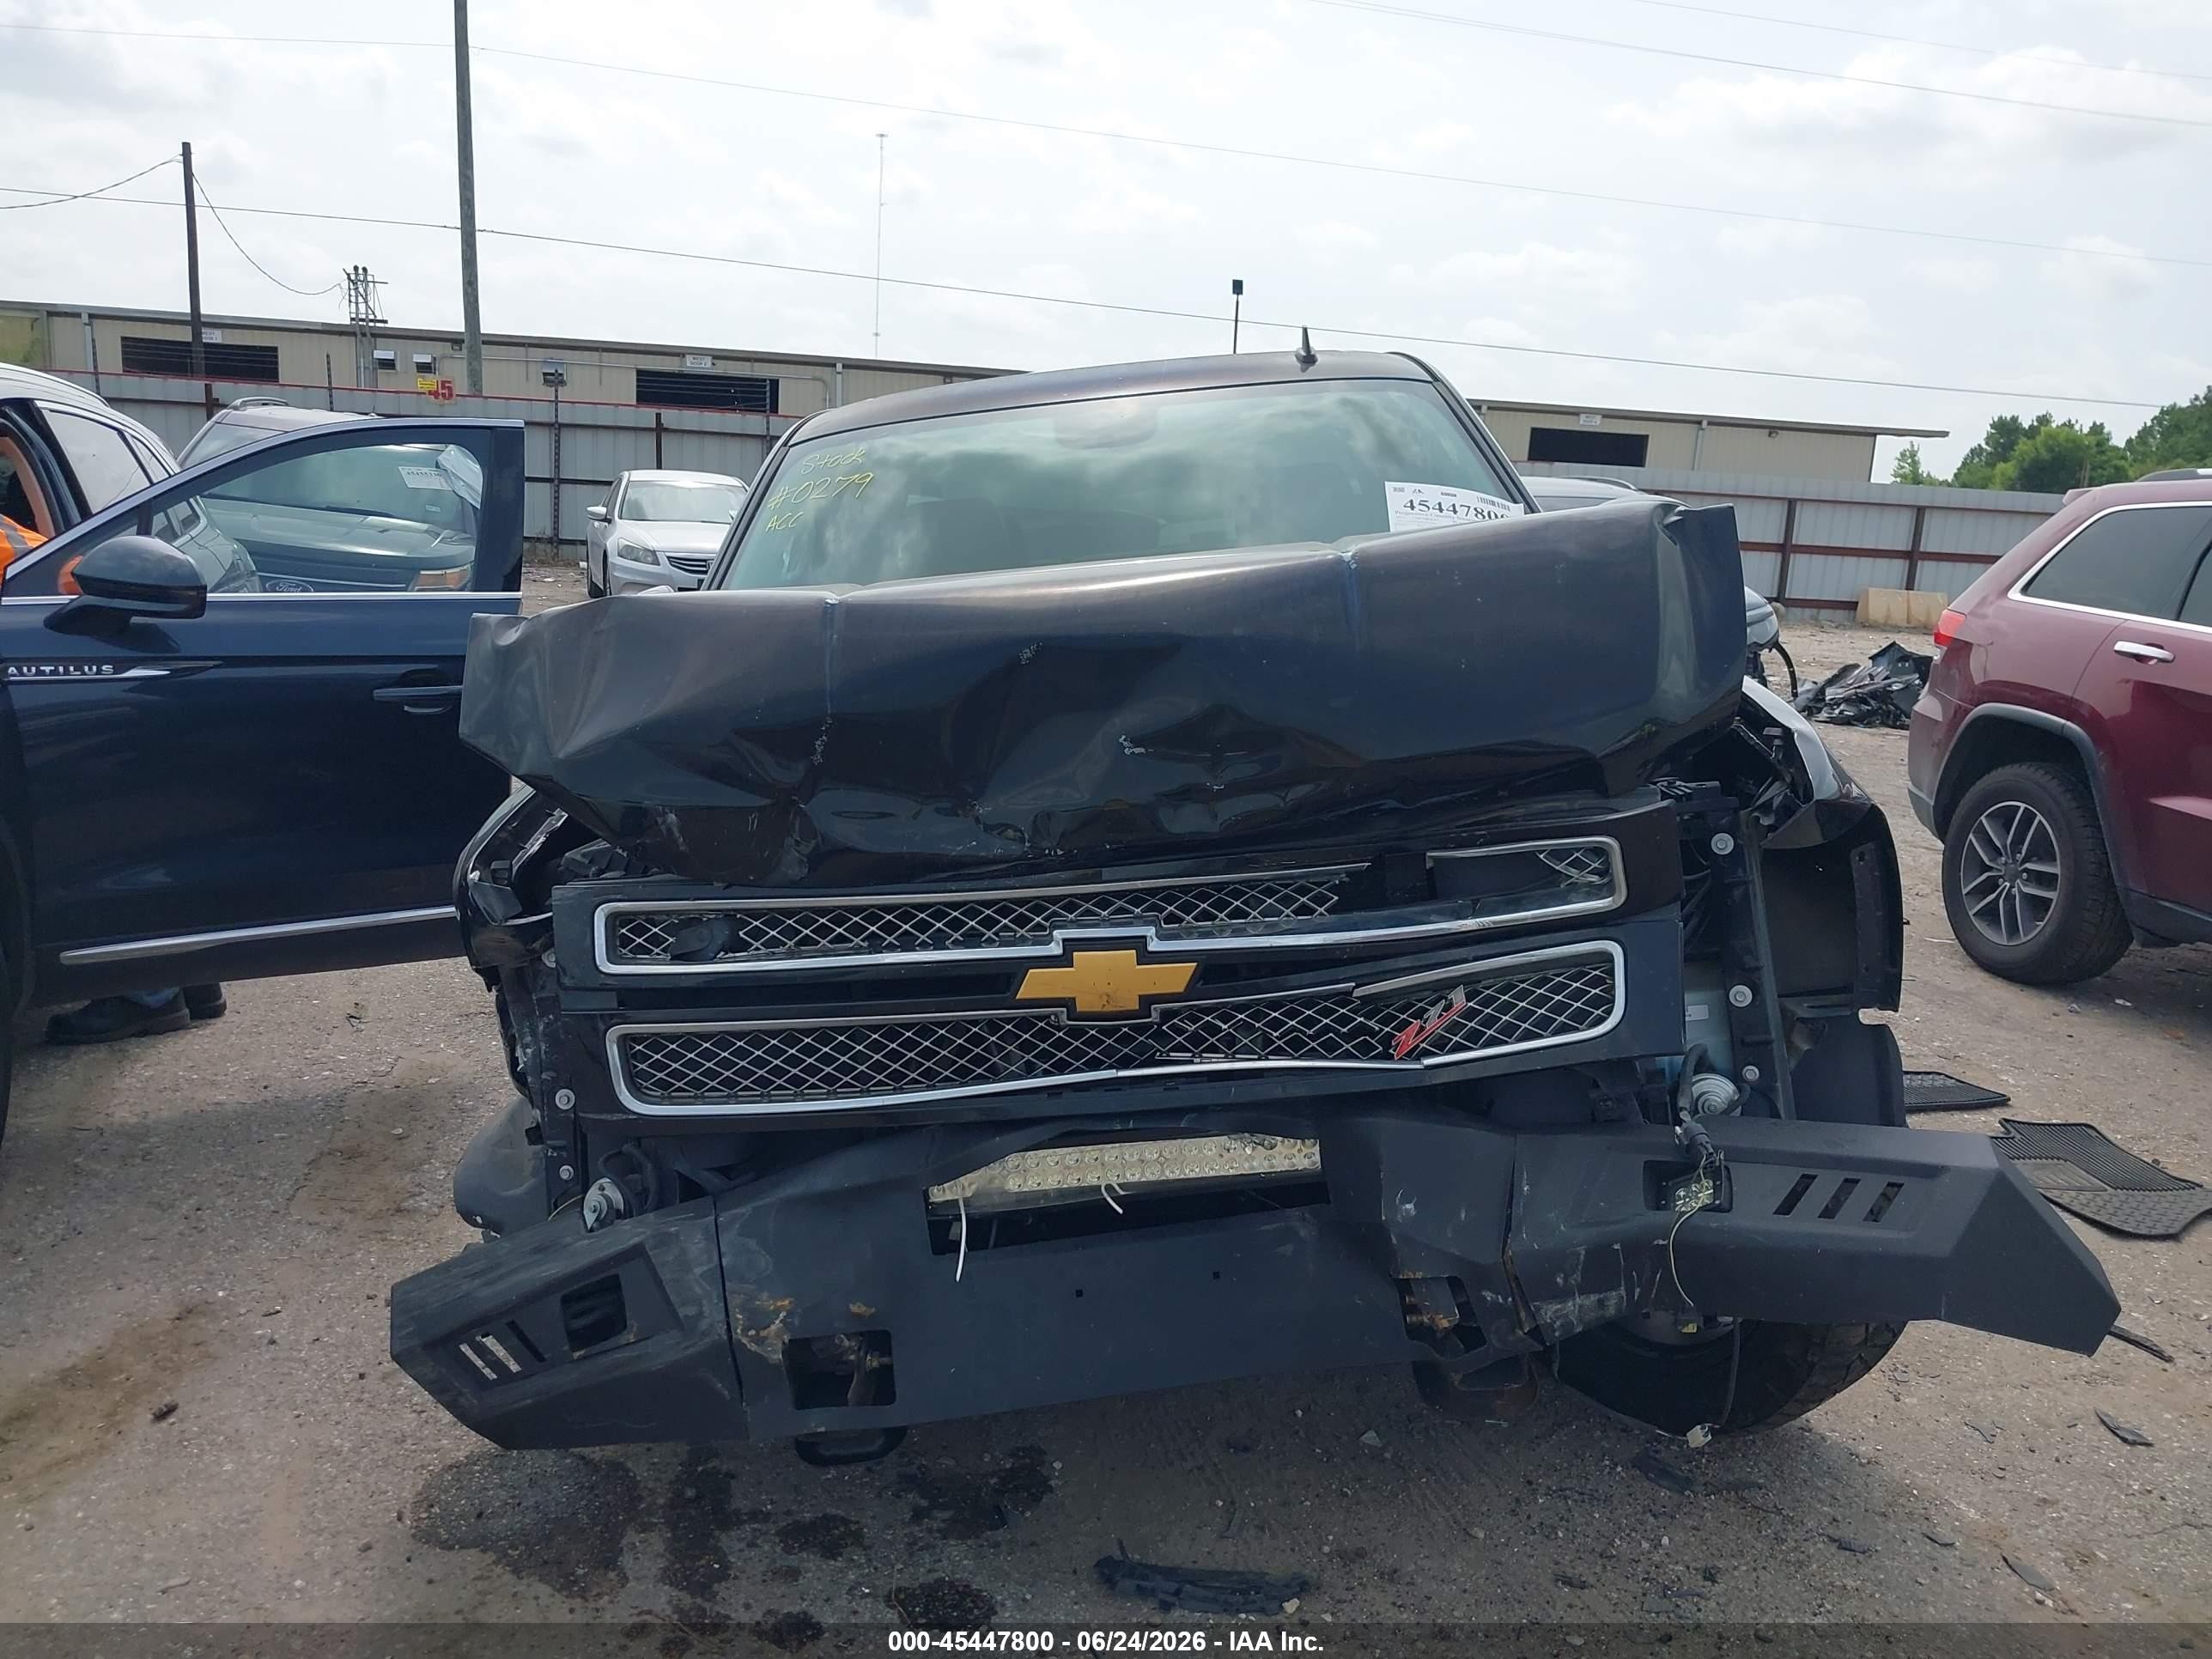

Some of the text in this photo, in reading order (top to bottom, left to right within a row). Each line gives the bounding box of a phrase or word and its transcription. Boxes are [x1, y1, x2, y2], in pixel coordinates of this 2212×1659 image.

[768, 472, 875, 510] #0279
[764, 511, 805, 532] ACC
[7, 665, 114, 677] AUTILUS
[1391, 983, 1468, 1060] Z71
